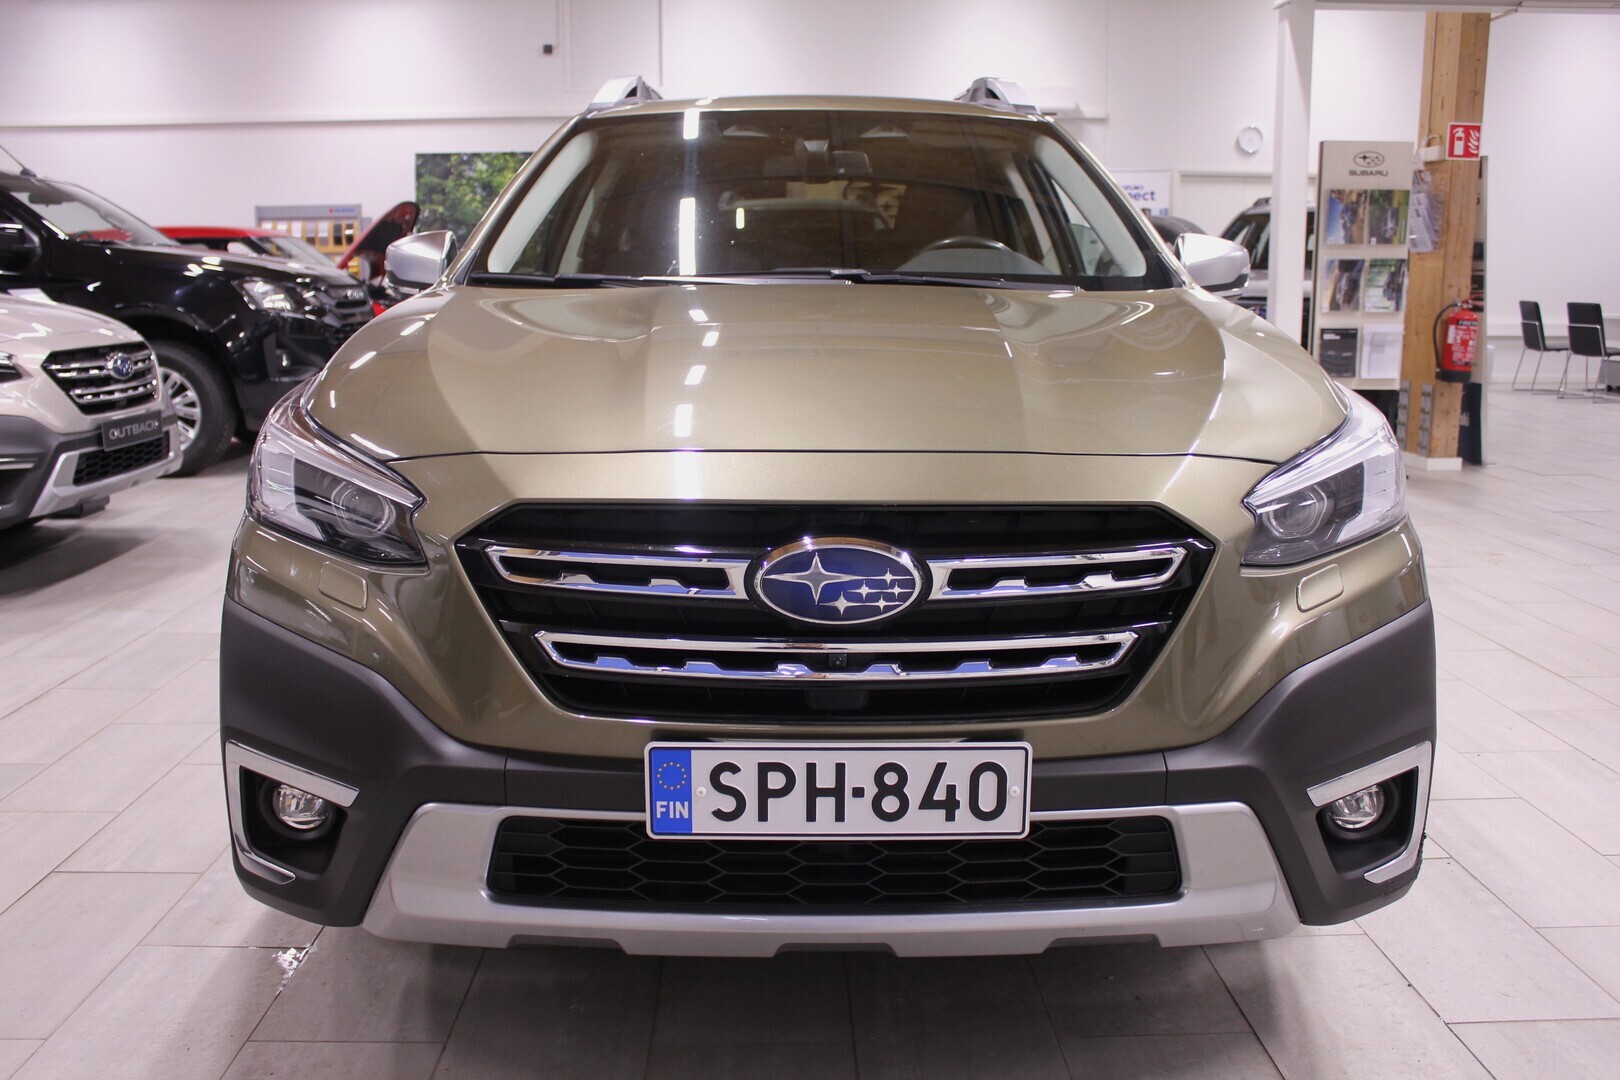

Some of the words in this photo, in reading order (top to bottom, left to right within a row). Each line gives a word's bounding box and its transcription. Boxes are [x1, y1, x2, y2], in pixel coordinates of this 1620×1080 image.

[109, 420, 158, 440] OUTBACK
[709, 761, 1008, 822] SPH-840
[656, 800, 688, 819] FIN
